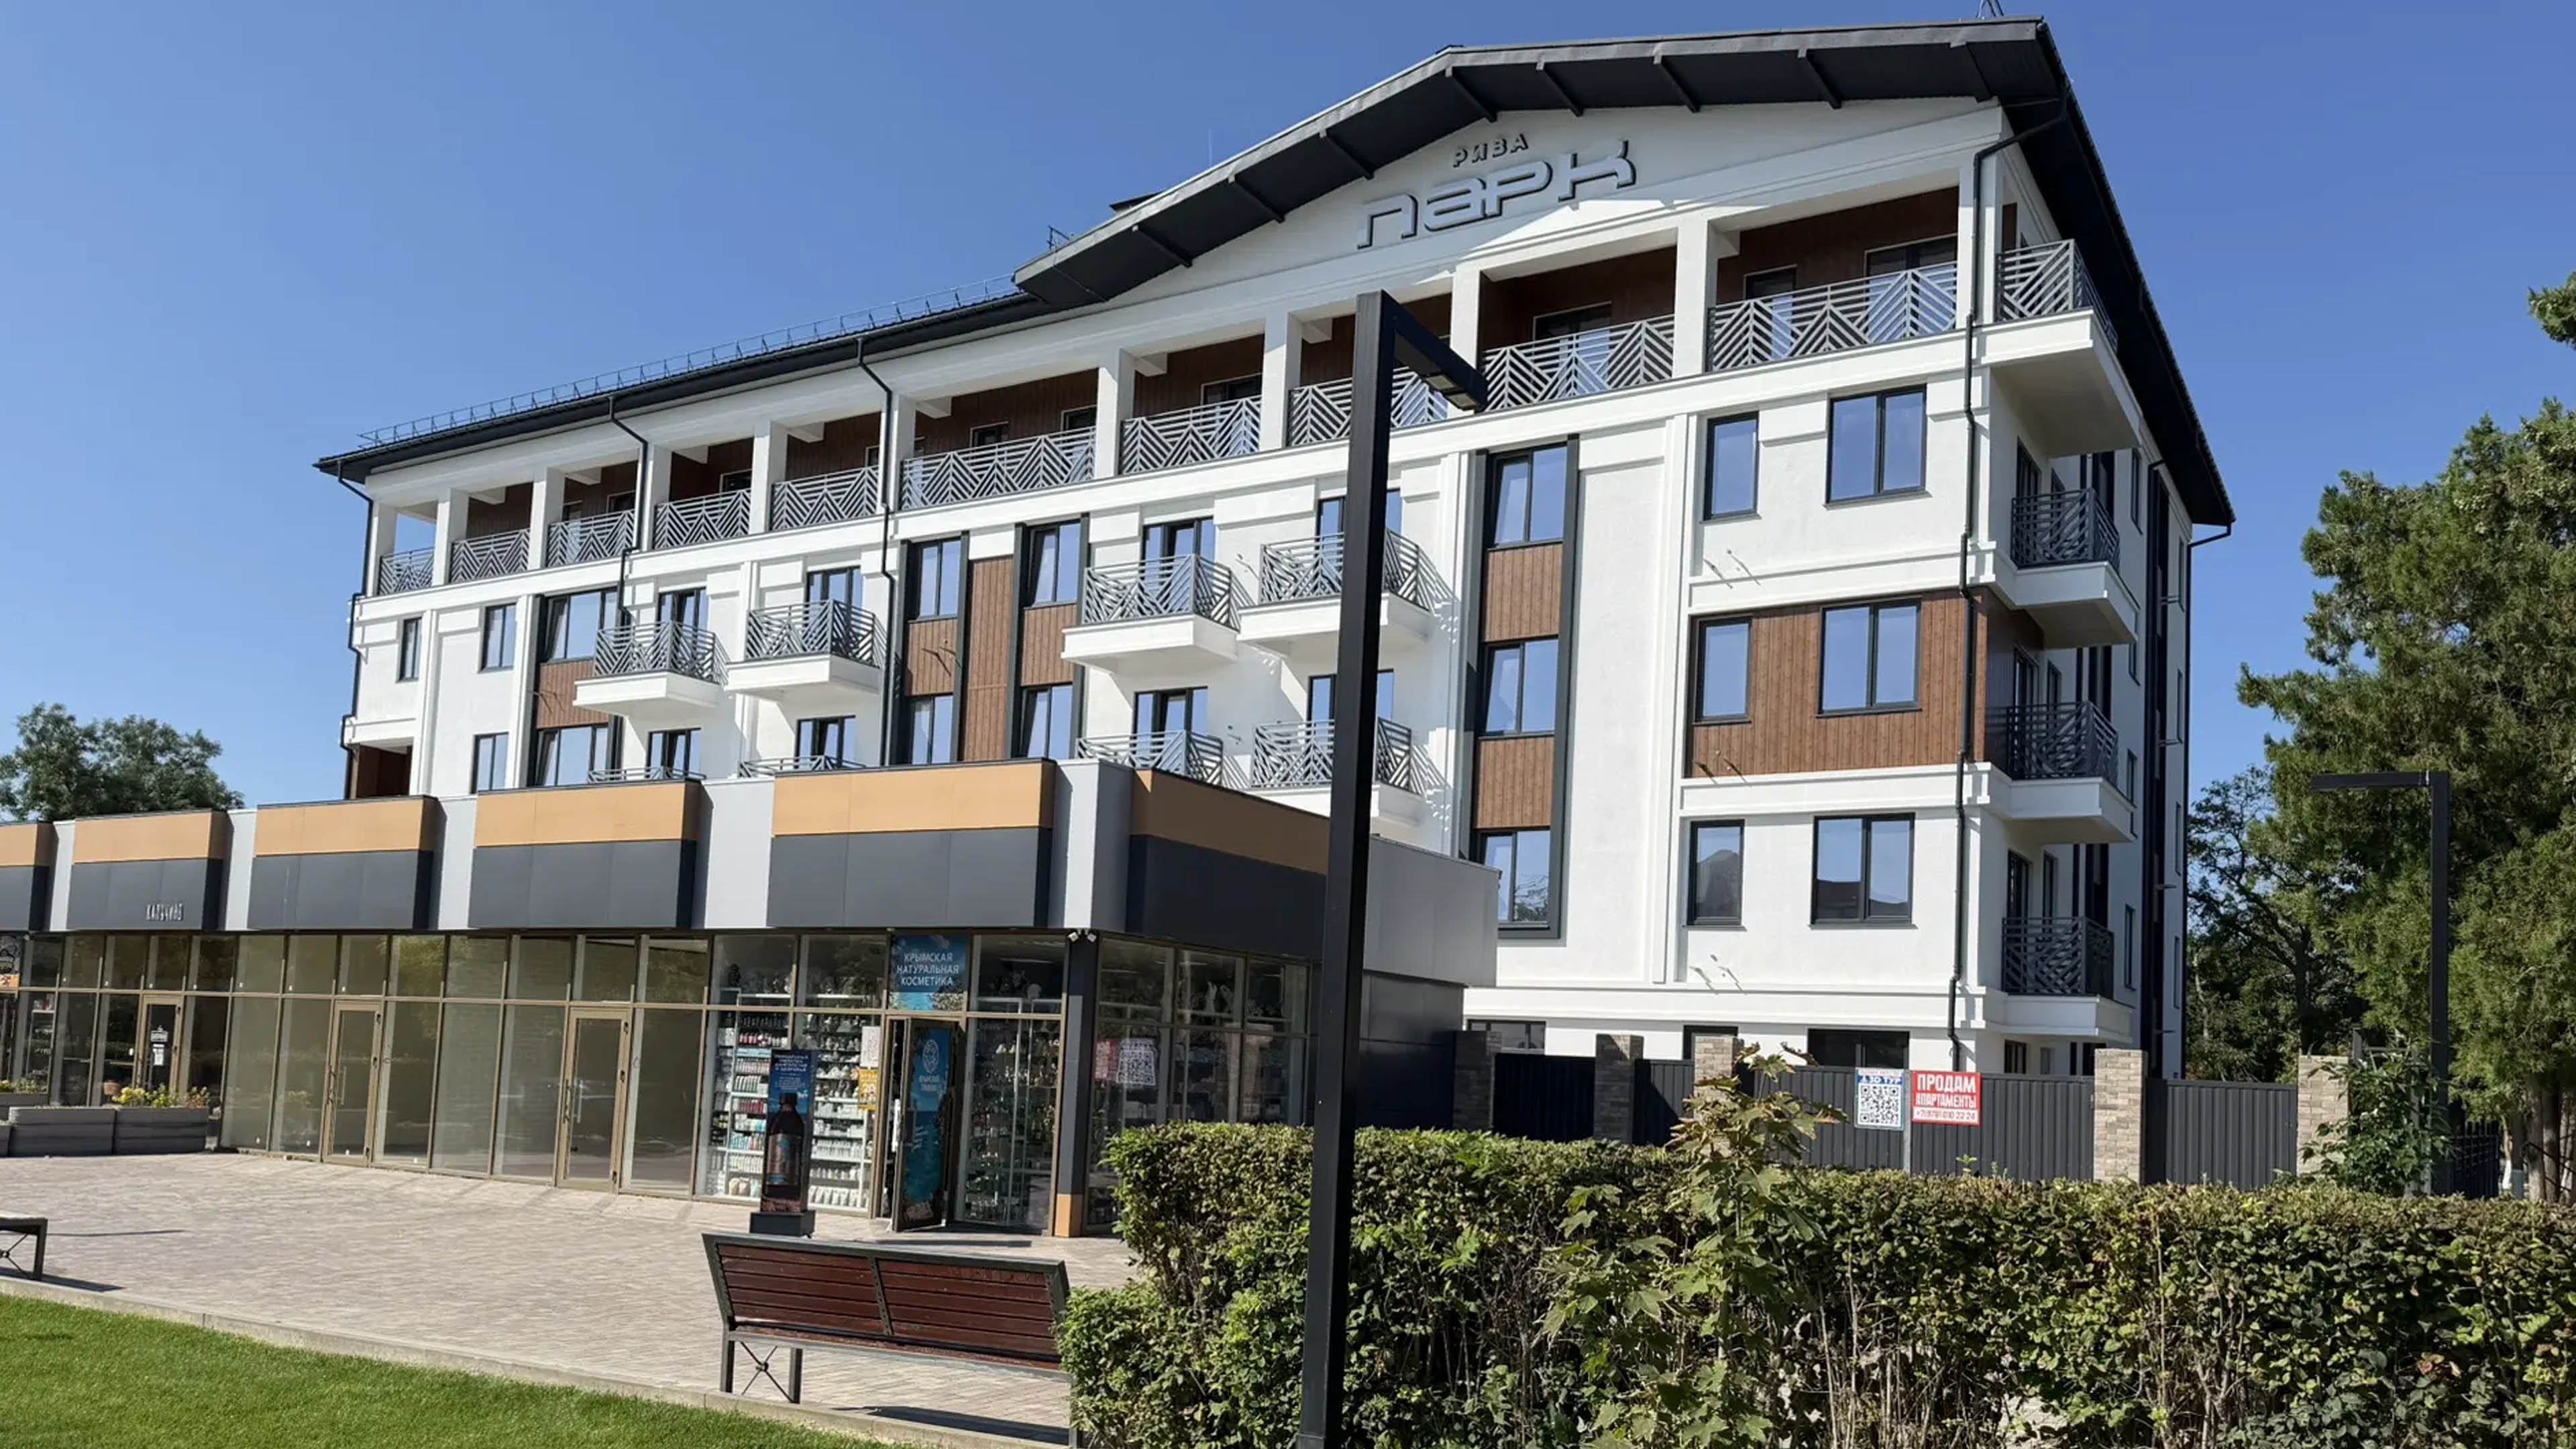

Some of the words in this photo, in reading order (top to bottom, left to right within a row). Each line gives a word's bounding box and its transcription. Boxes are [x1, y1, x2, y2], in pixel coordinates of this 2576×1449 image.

[1452, 133, 1529, 168] РИВА
[904, 953, 953, 963] КРЫМСКАЯ
[897, 965, 959, 975] НАТУРАЛЬНАЯ
[901, 976, 953, 986] КОСМЕТИКА
[1917, 1074, 1976, 1093] ПРОДАМ
[1915, 1093, 1976, 1109] АПАРТАМЕНТЫ
